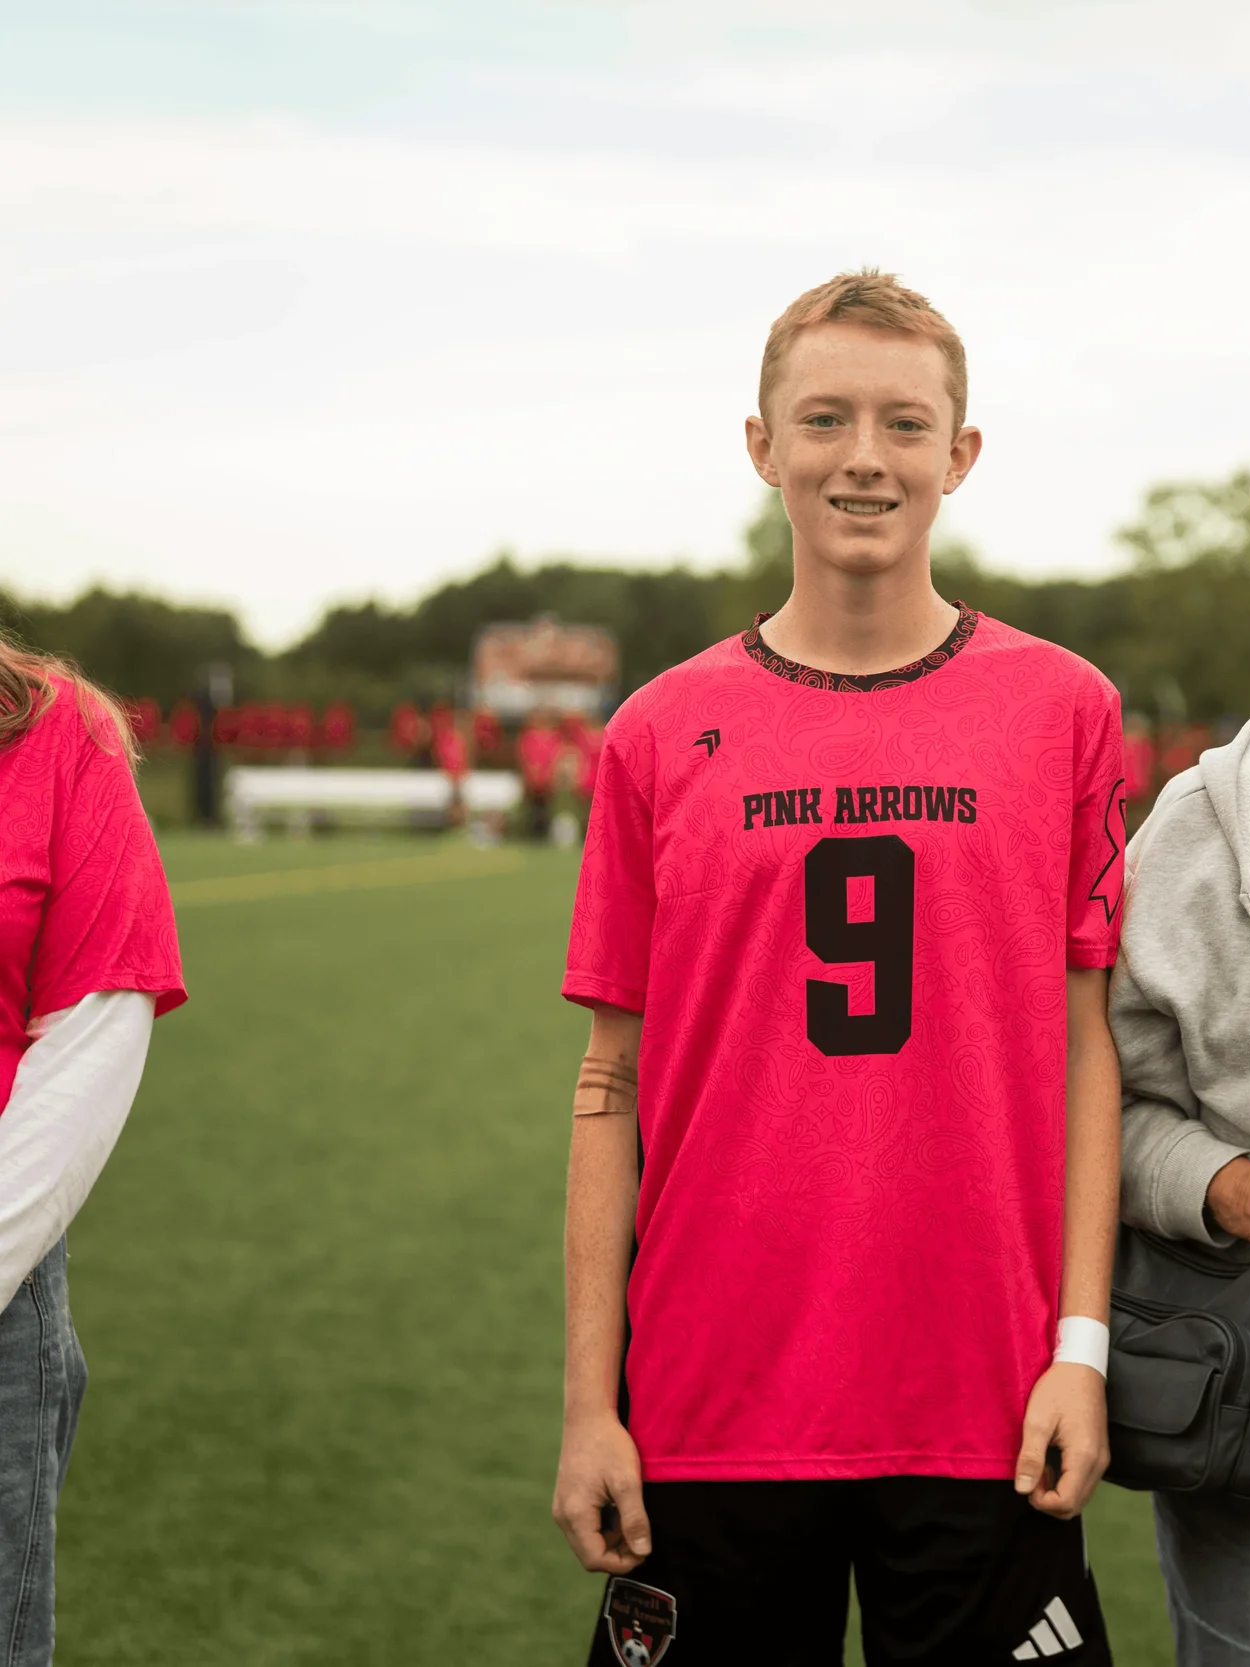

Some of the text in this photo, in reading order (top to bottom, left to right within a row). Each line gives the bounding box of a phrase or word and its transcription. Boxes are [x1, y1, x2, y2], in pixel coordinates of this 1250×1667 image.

[743, 786, 977, 831] PINK ARROWS
[805, 835, 915, 1057] 9
